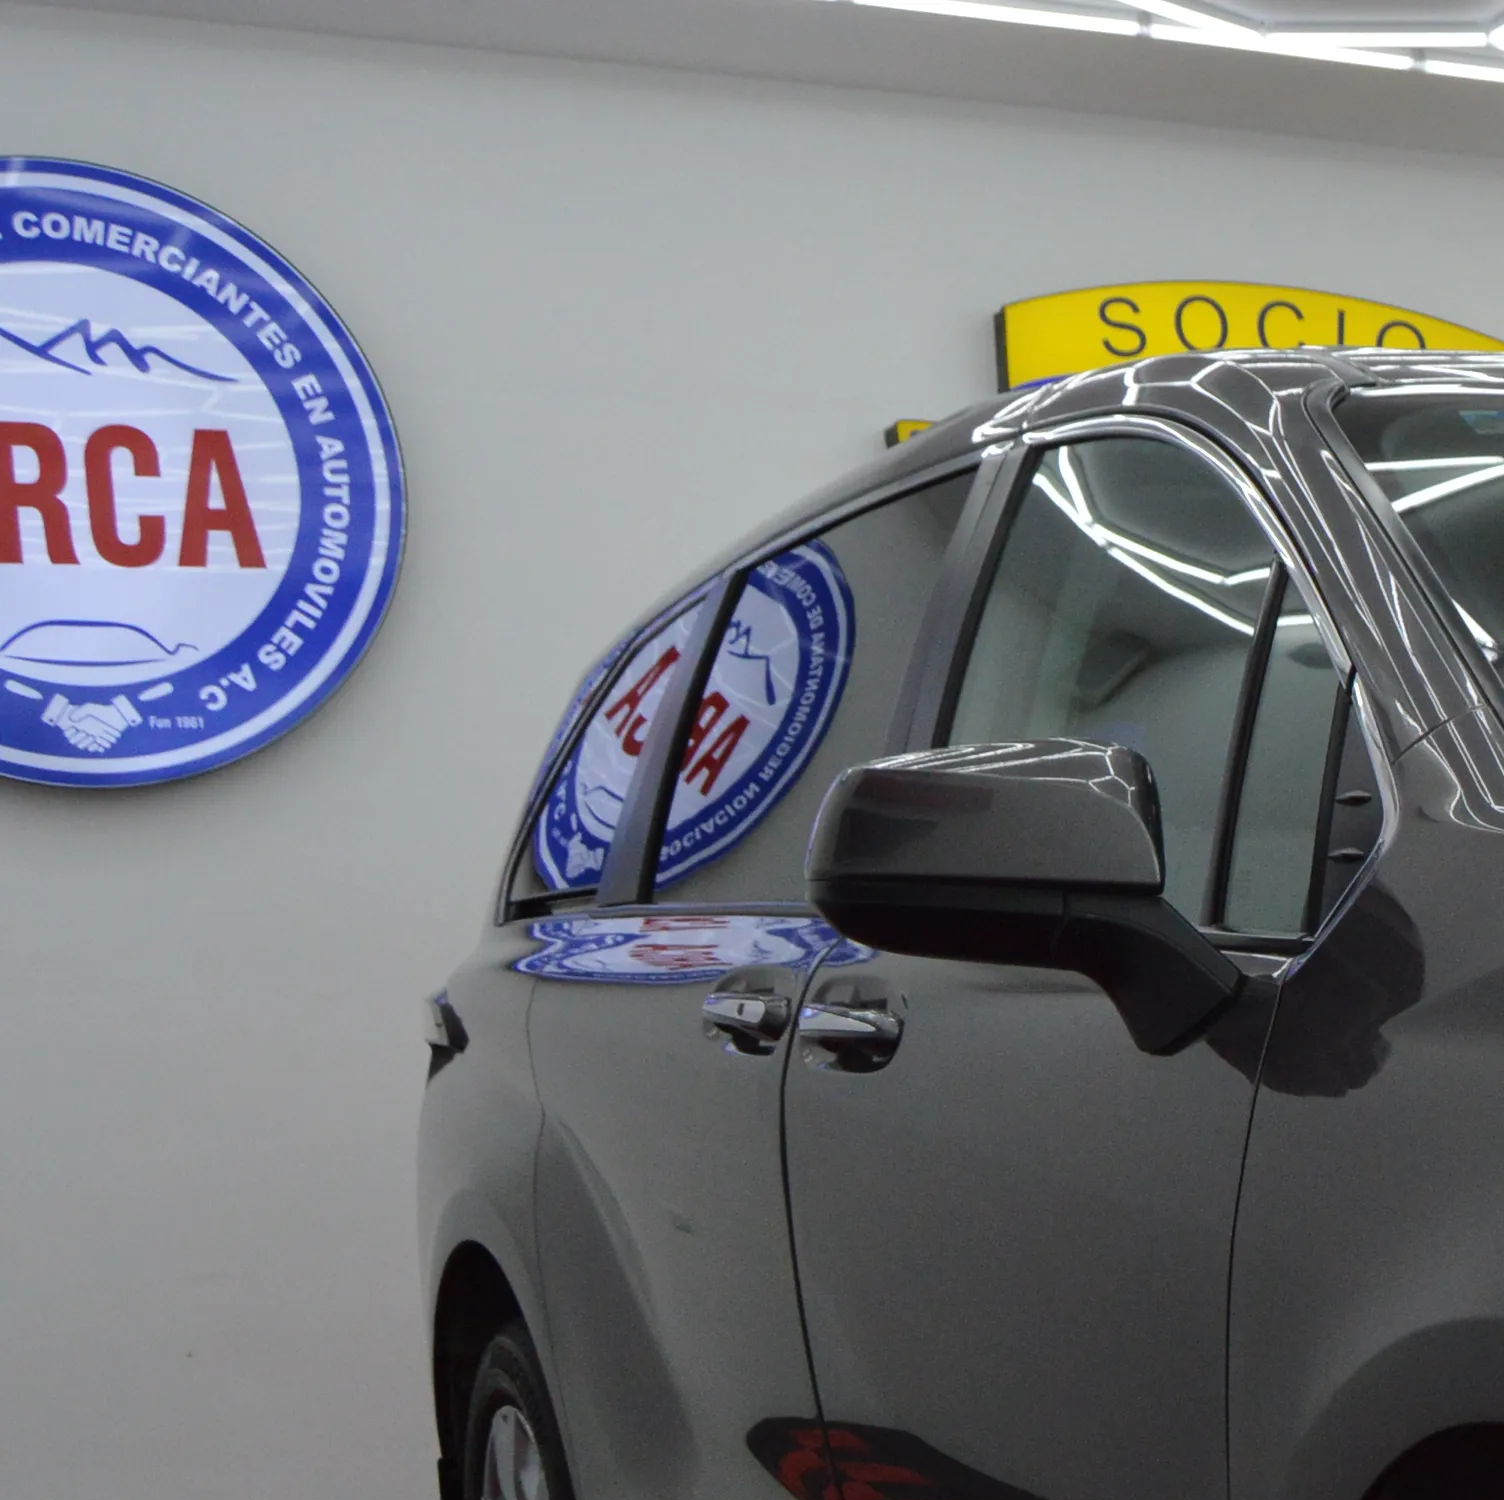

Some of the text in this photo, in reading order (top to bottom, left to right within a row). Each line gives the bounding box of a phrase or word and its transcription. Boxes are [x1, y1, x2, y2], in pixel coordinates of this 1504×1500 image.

[12, 211, 301, 369] COMERCIANTES
[292, 374, 335, 426] EN
[257, 436, 351, 671] AUTOMOVILES
